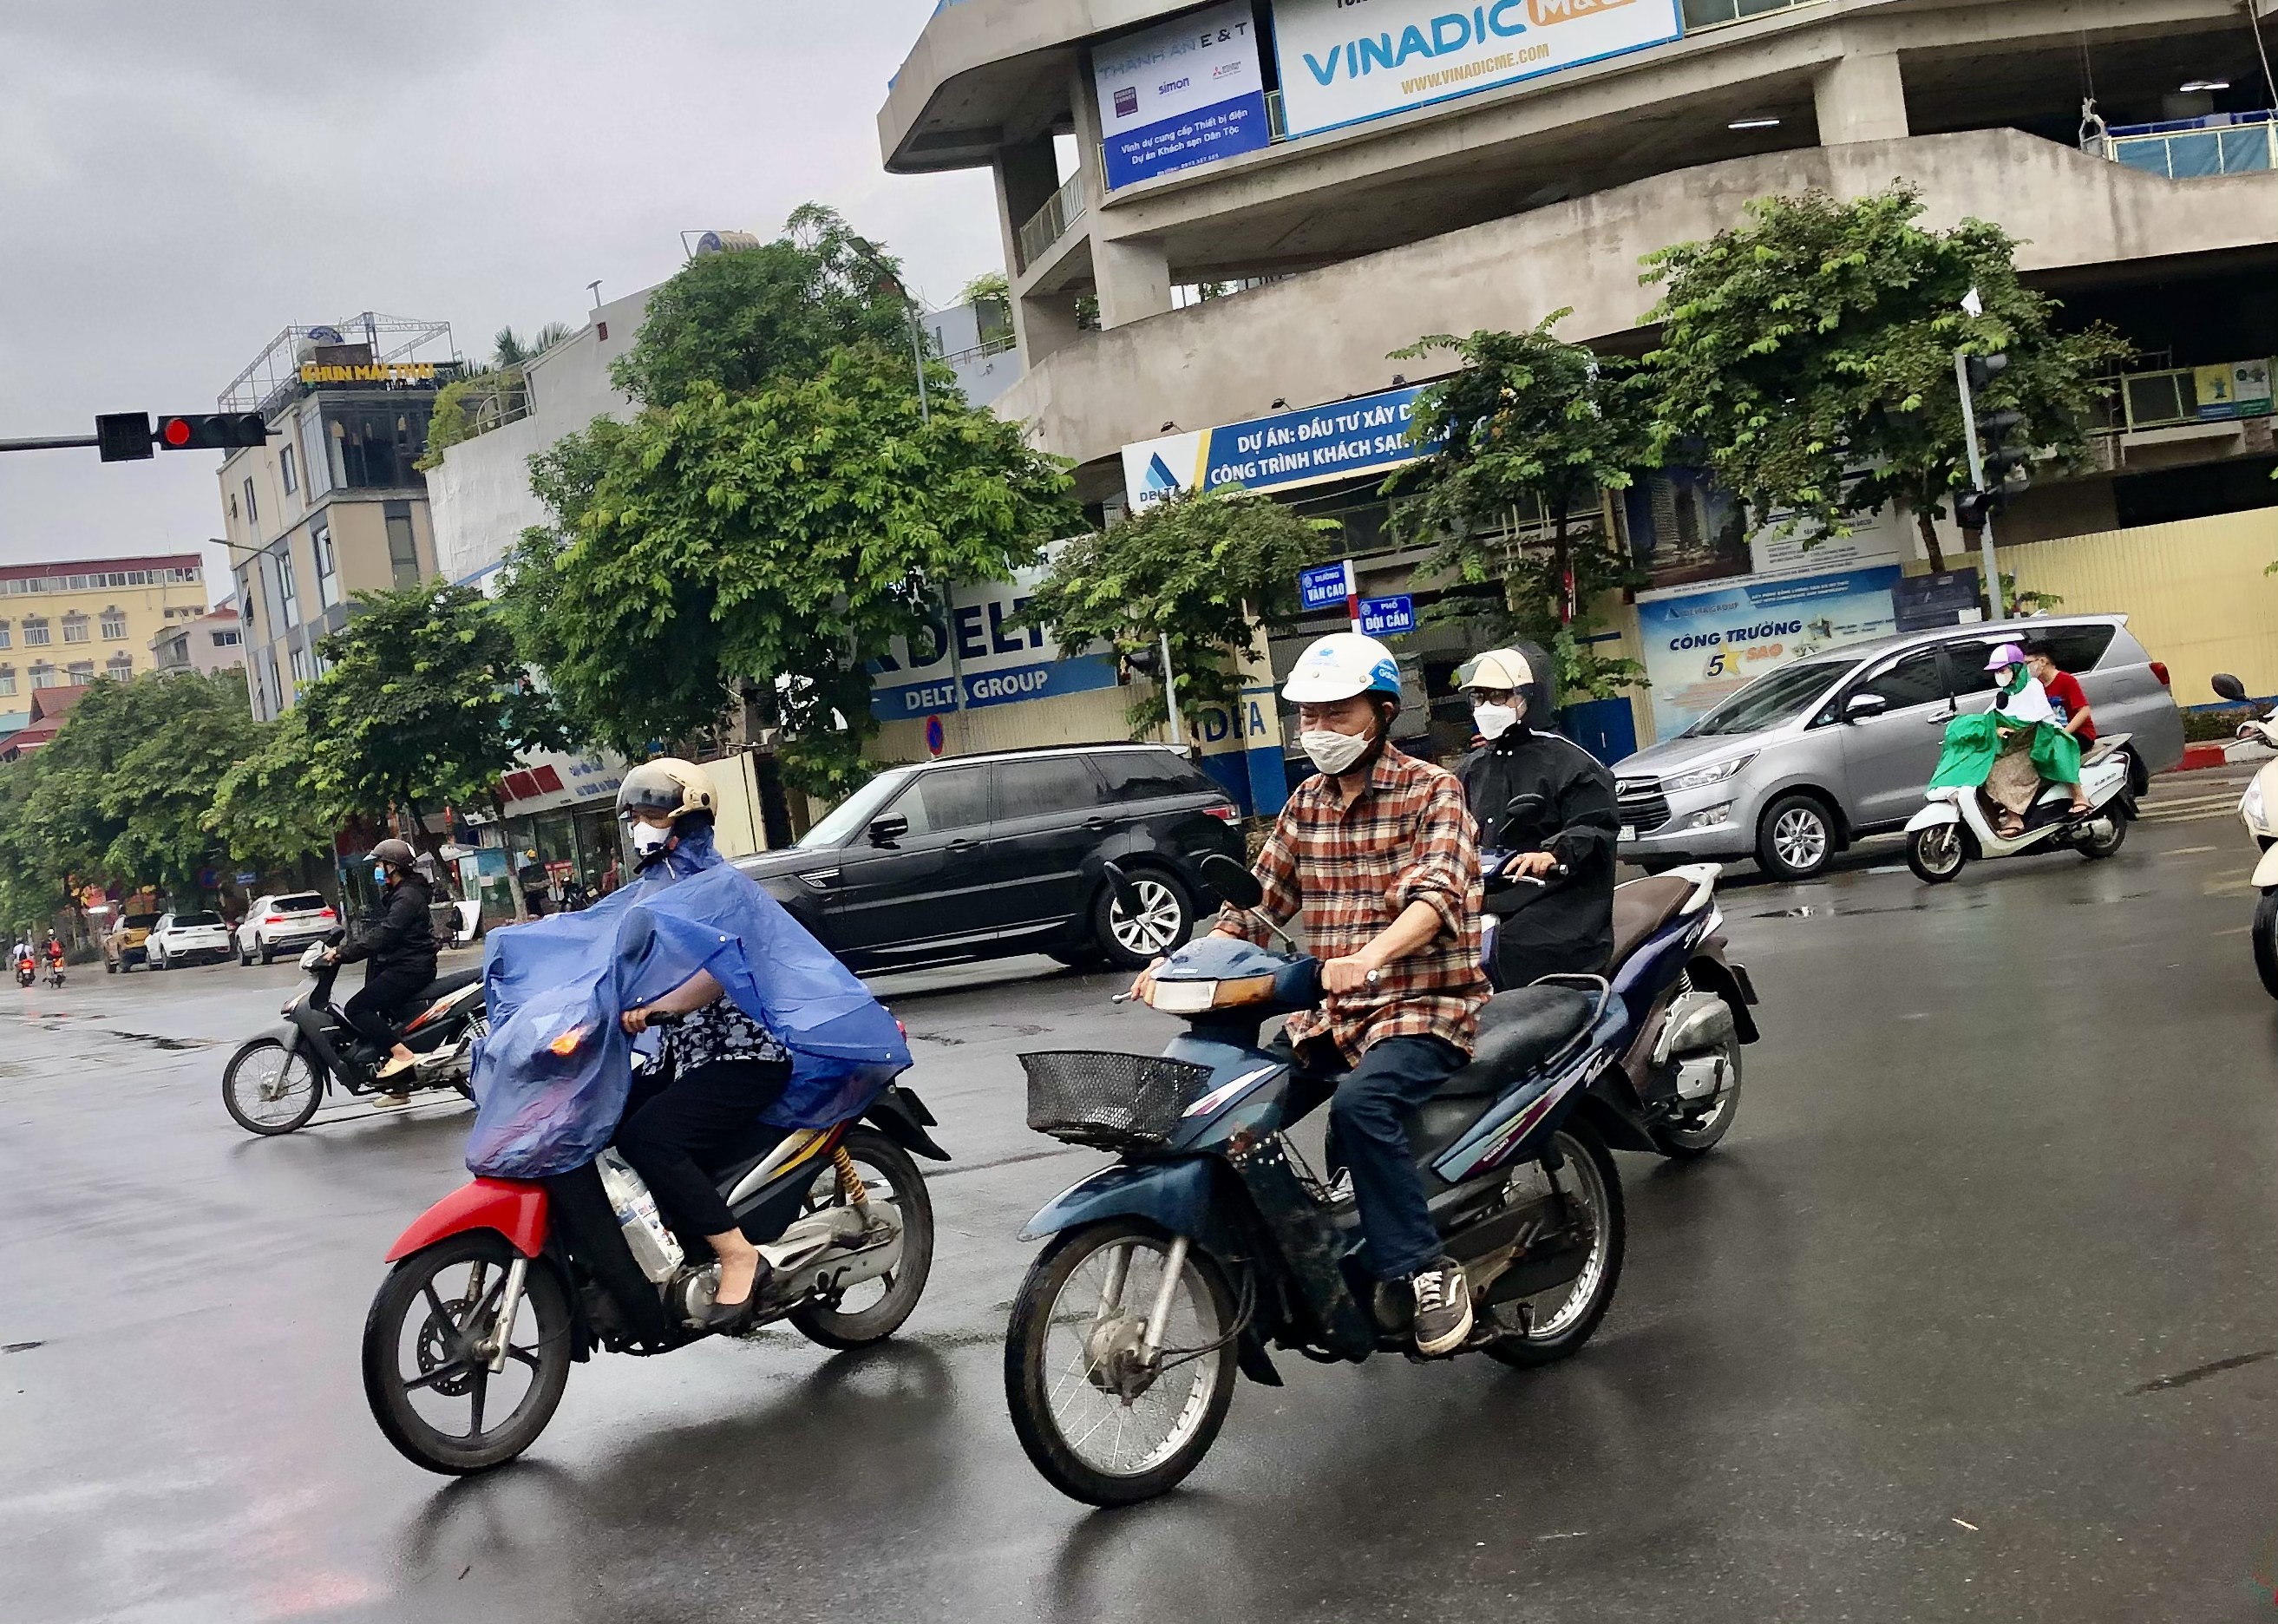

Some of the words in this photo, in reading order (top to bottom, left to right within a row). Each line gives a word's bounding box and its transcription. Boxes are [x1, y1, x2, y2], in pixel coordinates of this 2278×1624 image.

[1201, 34, 1213, 49] E
[1218, 29, 1231, 43] &
[1235, 22, 1247, 36] T
[1302, 0, 1527, 86] VINADIC
[1401, 43, 1550, 95] WWW.VINADICME.COM
[1159, 77, 1190, 95] simon
[1155, 131, 1175, 145] cung
[1195, 117, 1217, 132] Thiết
[1157, 141, 1185, 157] Khách
[1237, 432, 1261, 455] DỰ
[1266, 428, 1296, 449] ÁN:
[1298, 416, 1334, 441] ĐẦU
[1336, 411, 1360, 432] TƯ
[1363, 404, 1396, 428] XÂY
[1210, 462, 1256, 486] CÔNG
[1258, 450, 1310, 476] TRÌNH
[1312, 438, 1371, 465] KHÁCH
[1307, 585, 1326, 602] VĂN
[1326, 582, 1345, 598] CAO
[1380, 599, 1398, 611] PHỐ
[1365, 613, 1384, 632] ĐỘI
[1386, 610, 1410, 627] CẤN
[1670, 632, 1721, 652] CÔNG
[1726, 619, 1803, 644] TRƯỜNG
[1707, 653, 1726, 678] 5
[1746, 643, 1784, 661] SAO
[973, 670, 1048, 699] GROUP
